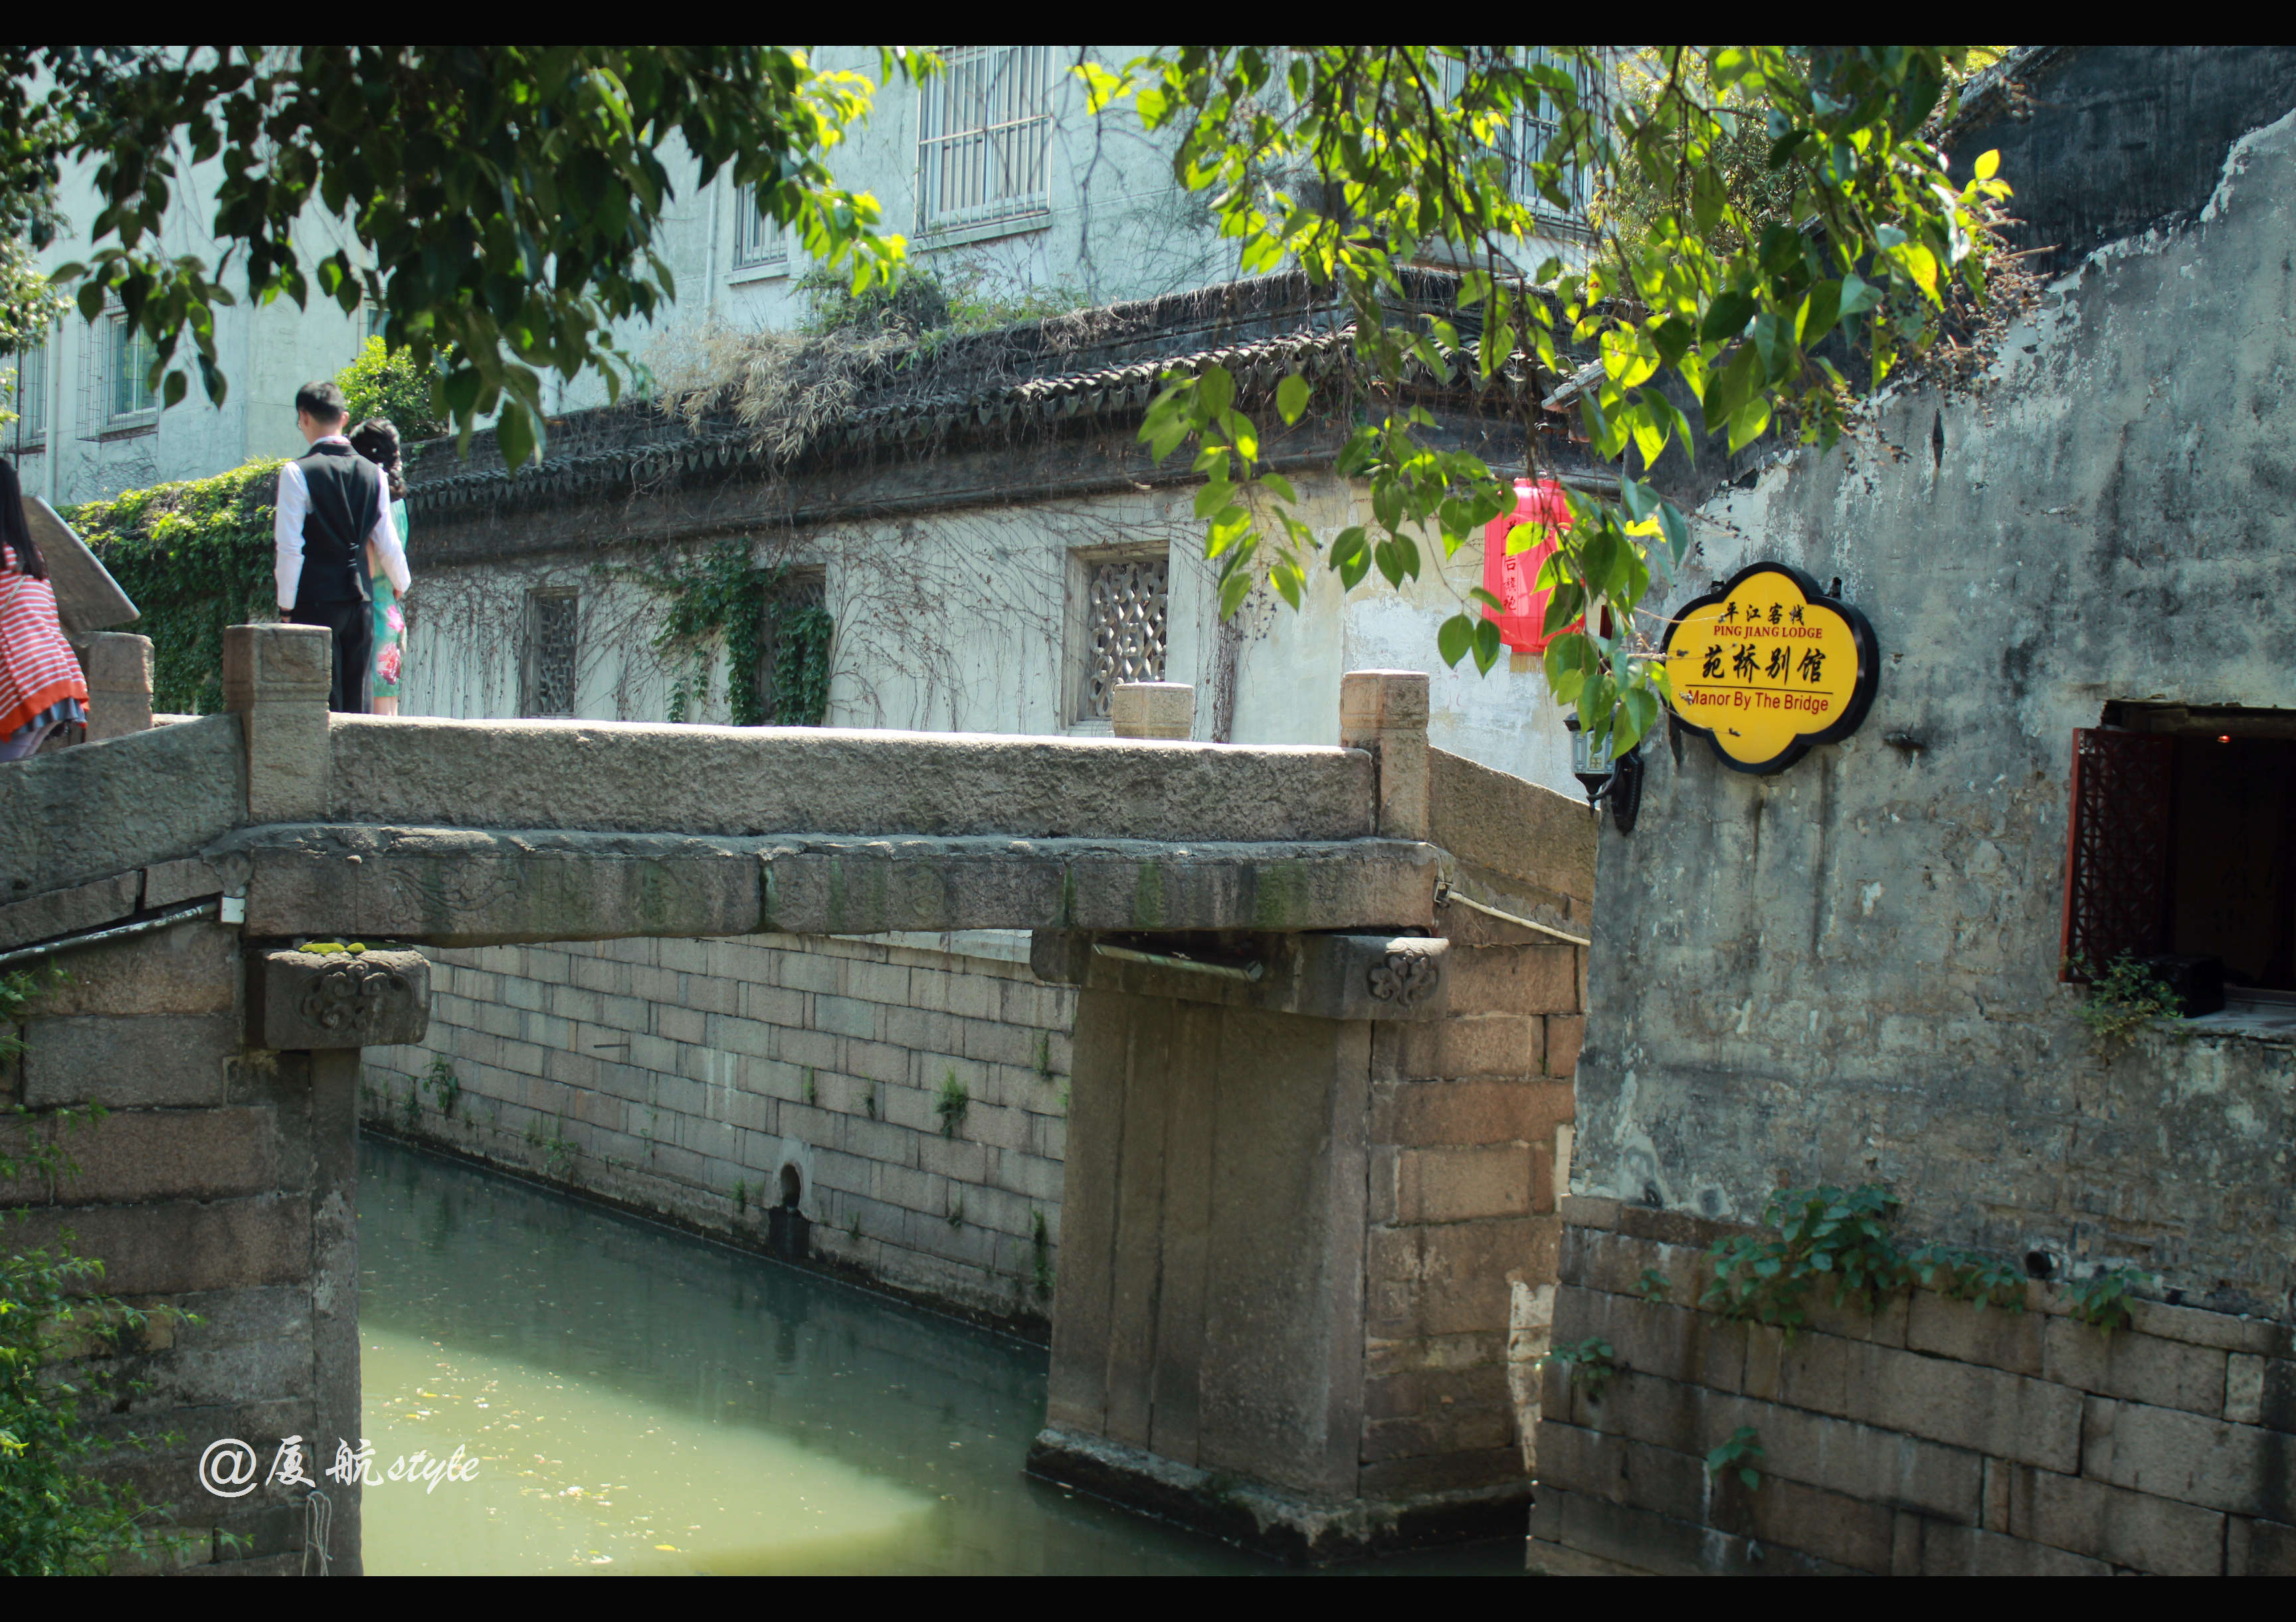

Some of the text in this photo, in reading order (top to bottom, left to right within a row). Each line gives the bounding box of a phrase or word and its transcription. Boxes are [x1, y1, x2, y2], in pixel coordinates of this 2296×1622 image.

[1724, 601, 1804, 626] 平江客栈
[1713, 626, 1822, 639] PING JIANG LODGE
[1703, 644, 1826, 685] 苑桥别馆
[1687, 689, 1828, 715] Manor By The Bridge
